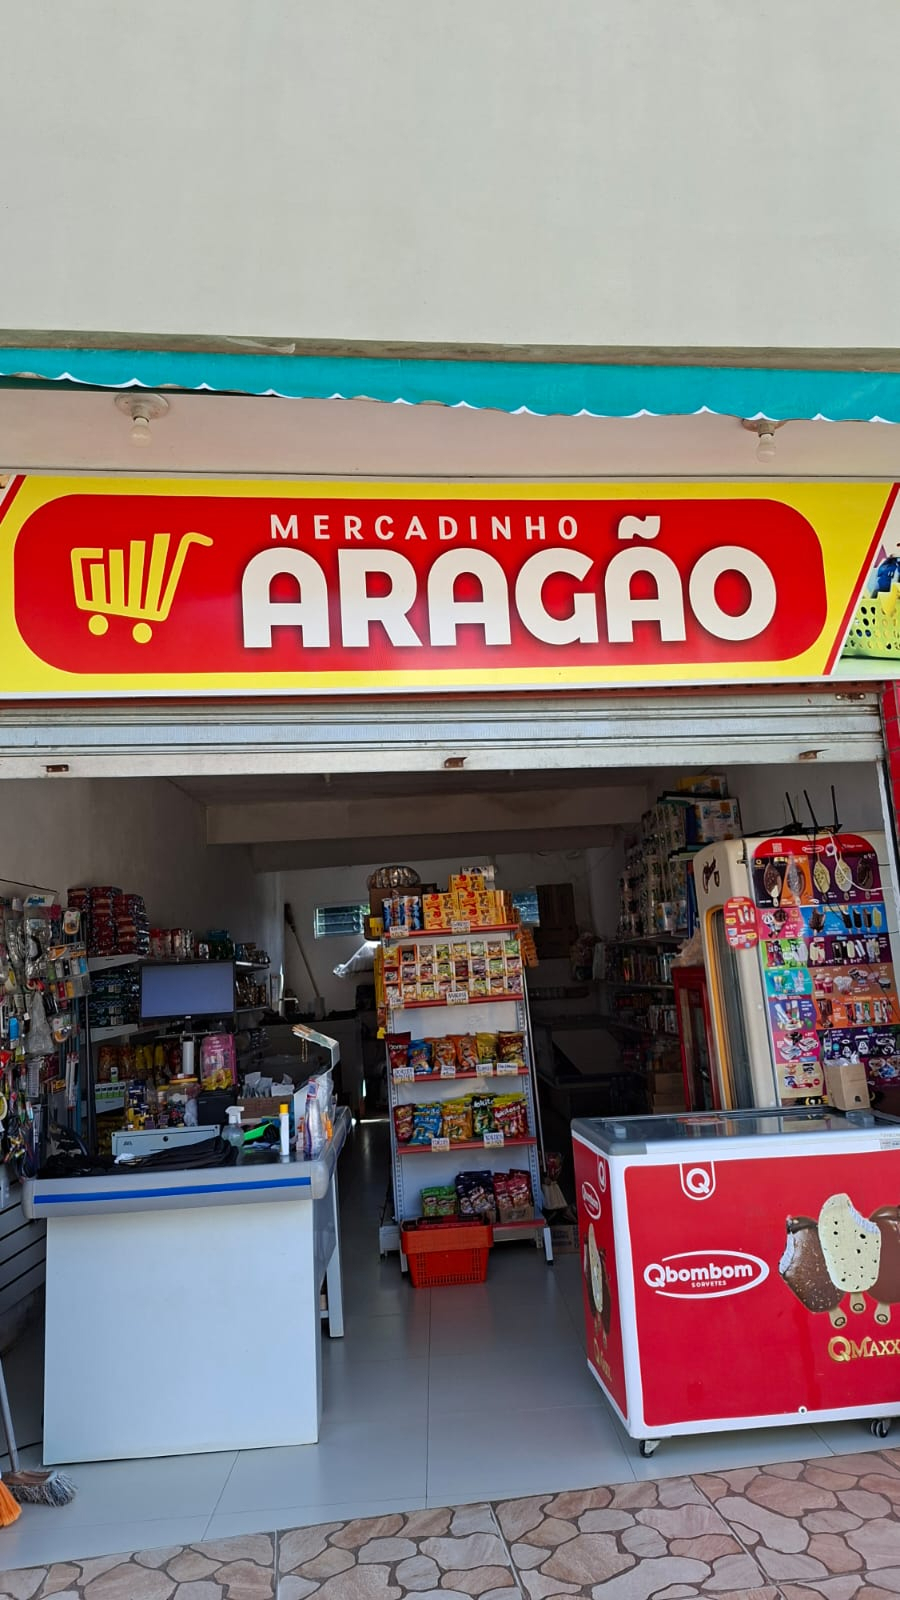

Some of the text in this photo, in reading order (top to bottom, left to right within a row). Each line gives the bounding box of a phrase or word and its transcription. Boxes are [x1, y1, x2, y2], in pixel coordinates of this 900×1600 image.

[271, 514, 578, 541] MERCADINHO
[242, 514, 777, 649] ARAGÃO
[686, 1167, 710, 1194] Q
[643, 1263, 753, 1288] Qbombom
[691, 1280, 727, 1288] SORVETES
